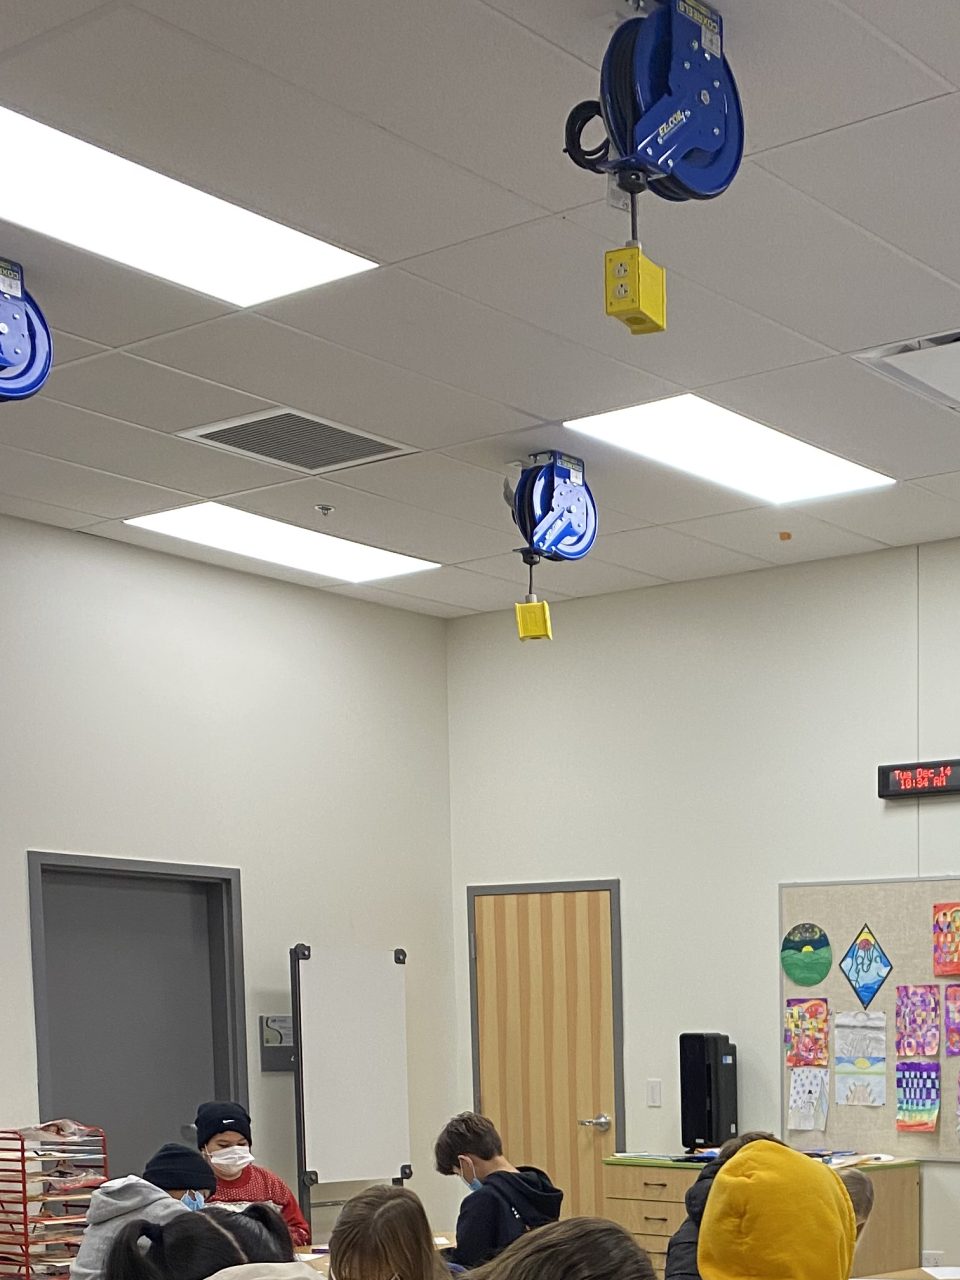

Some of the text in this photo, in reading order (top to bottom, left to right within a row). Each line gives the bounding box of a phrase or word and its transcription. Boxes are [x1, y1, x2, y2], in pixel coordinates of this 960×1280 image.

[894, 766, 951, 780] Tue Dec 14
[900, 776, 946, 789] 10:34 AM
